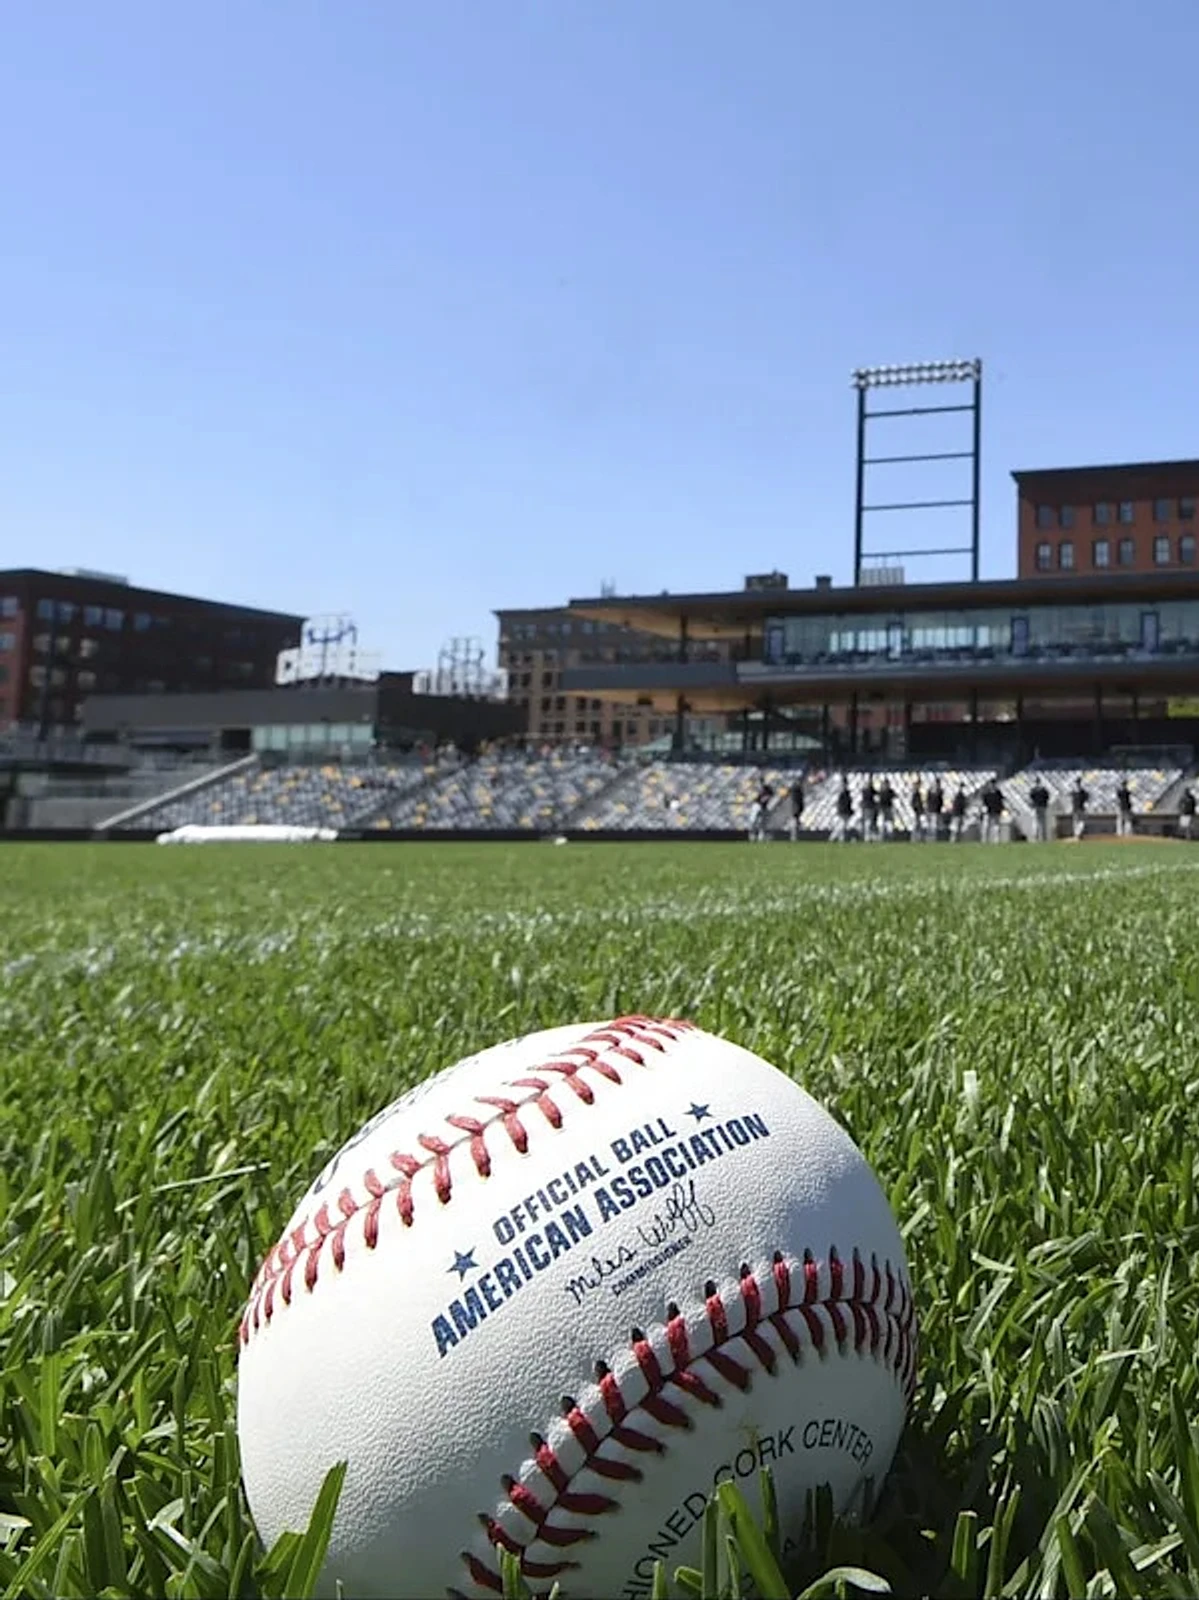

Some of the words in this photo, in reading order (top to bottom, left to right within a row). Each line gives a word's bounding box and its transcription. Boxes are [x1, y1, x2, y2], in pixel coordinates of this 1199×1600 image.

[430, 1204, 594, 1358] AMERICAN
[593, 1113, 770, 1224] ASSOCIATION
[492, 1155, 610, 1246] OFFICIAL
[609, 1117, 677, 1164] BALL
[713, 1425, 796, 1486] CORK
[802, 1419, 874, 1469] CENTER
